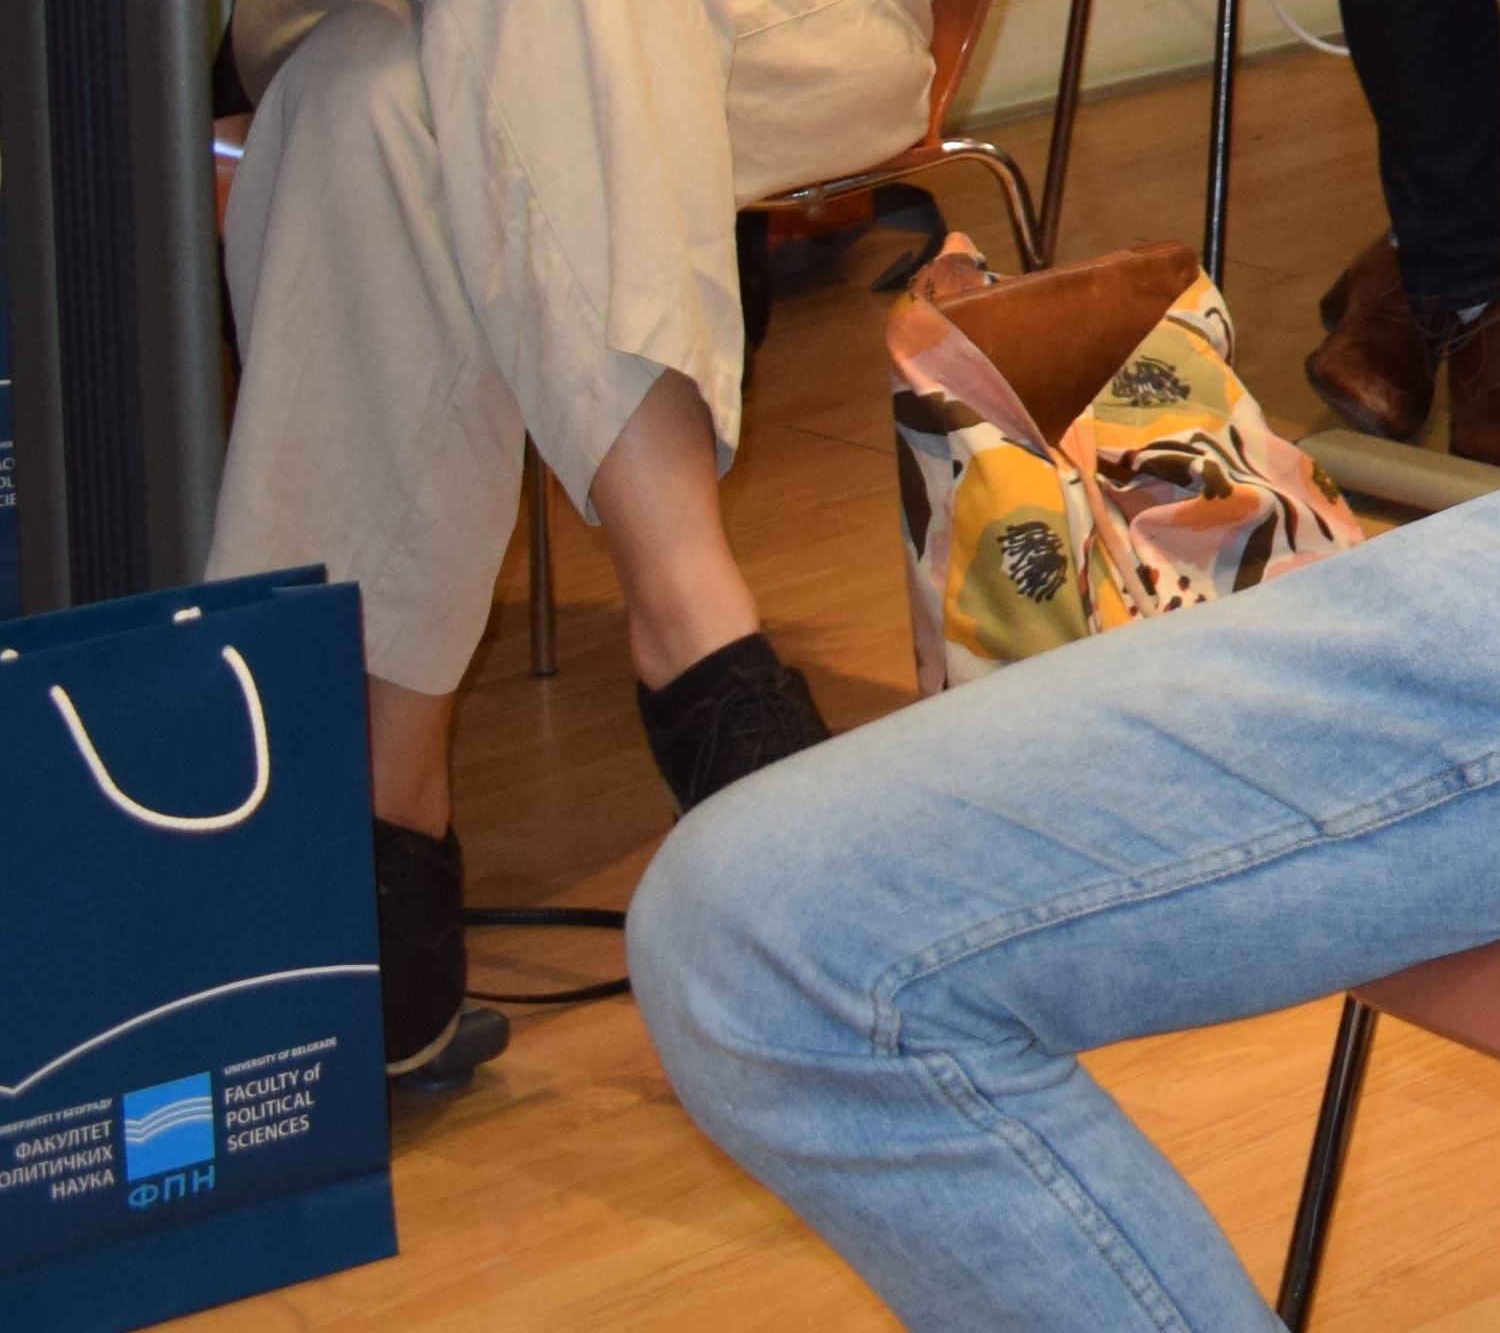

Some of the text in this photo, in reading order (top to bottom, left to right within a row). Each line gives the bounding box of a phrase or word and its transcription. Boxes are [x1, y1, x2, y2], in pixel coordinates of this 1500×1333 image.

[223, 1036, 338, 1076] UNIVERSITY OF BELGRADE
[223, 1061, 323, 1105] FACULTY of
[226, 1090, 315, 1129] POLITICAL
[15, 1120, 113, 1159] ФАКУЛТЕТ
[227, 1114, 311, 1153] SCIENCES
[0, 1144, 113, 1187] ОЛИТИЧКИХ
[52, 1170, 115, 1200] НАУКА
[127, 1165, 216, 1209] ФПН
